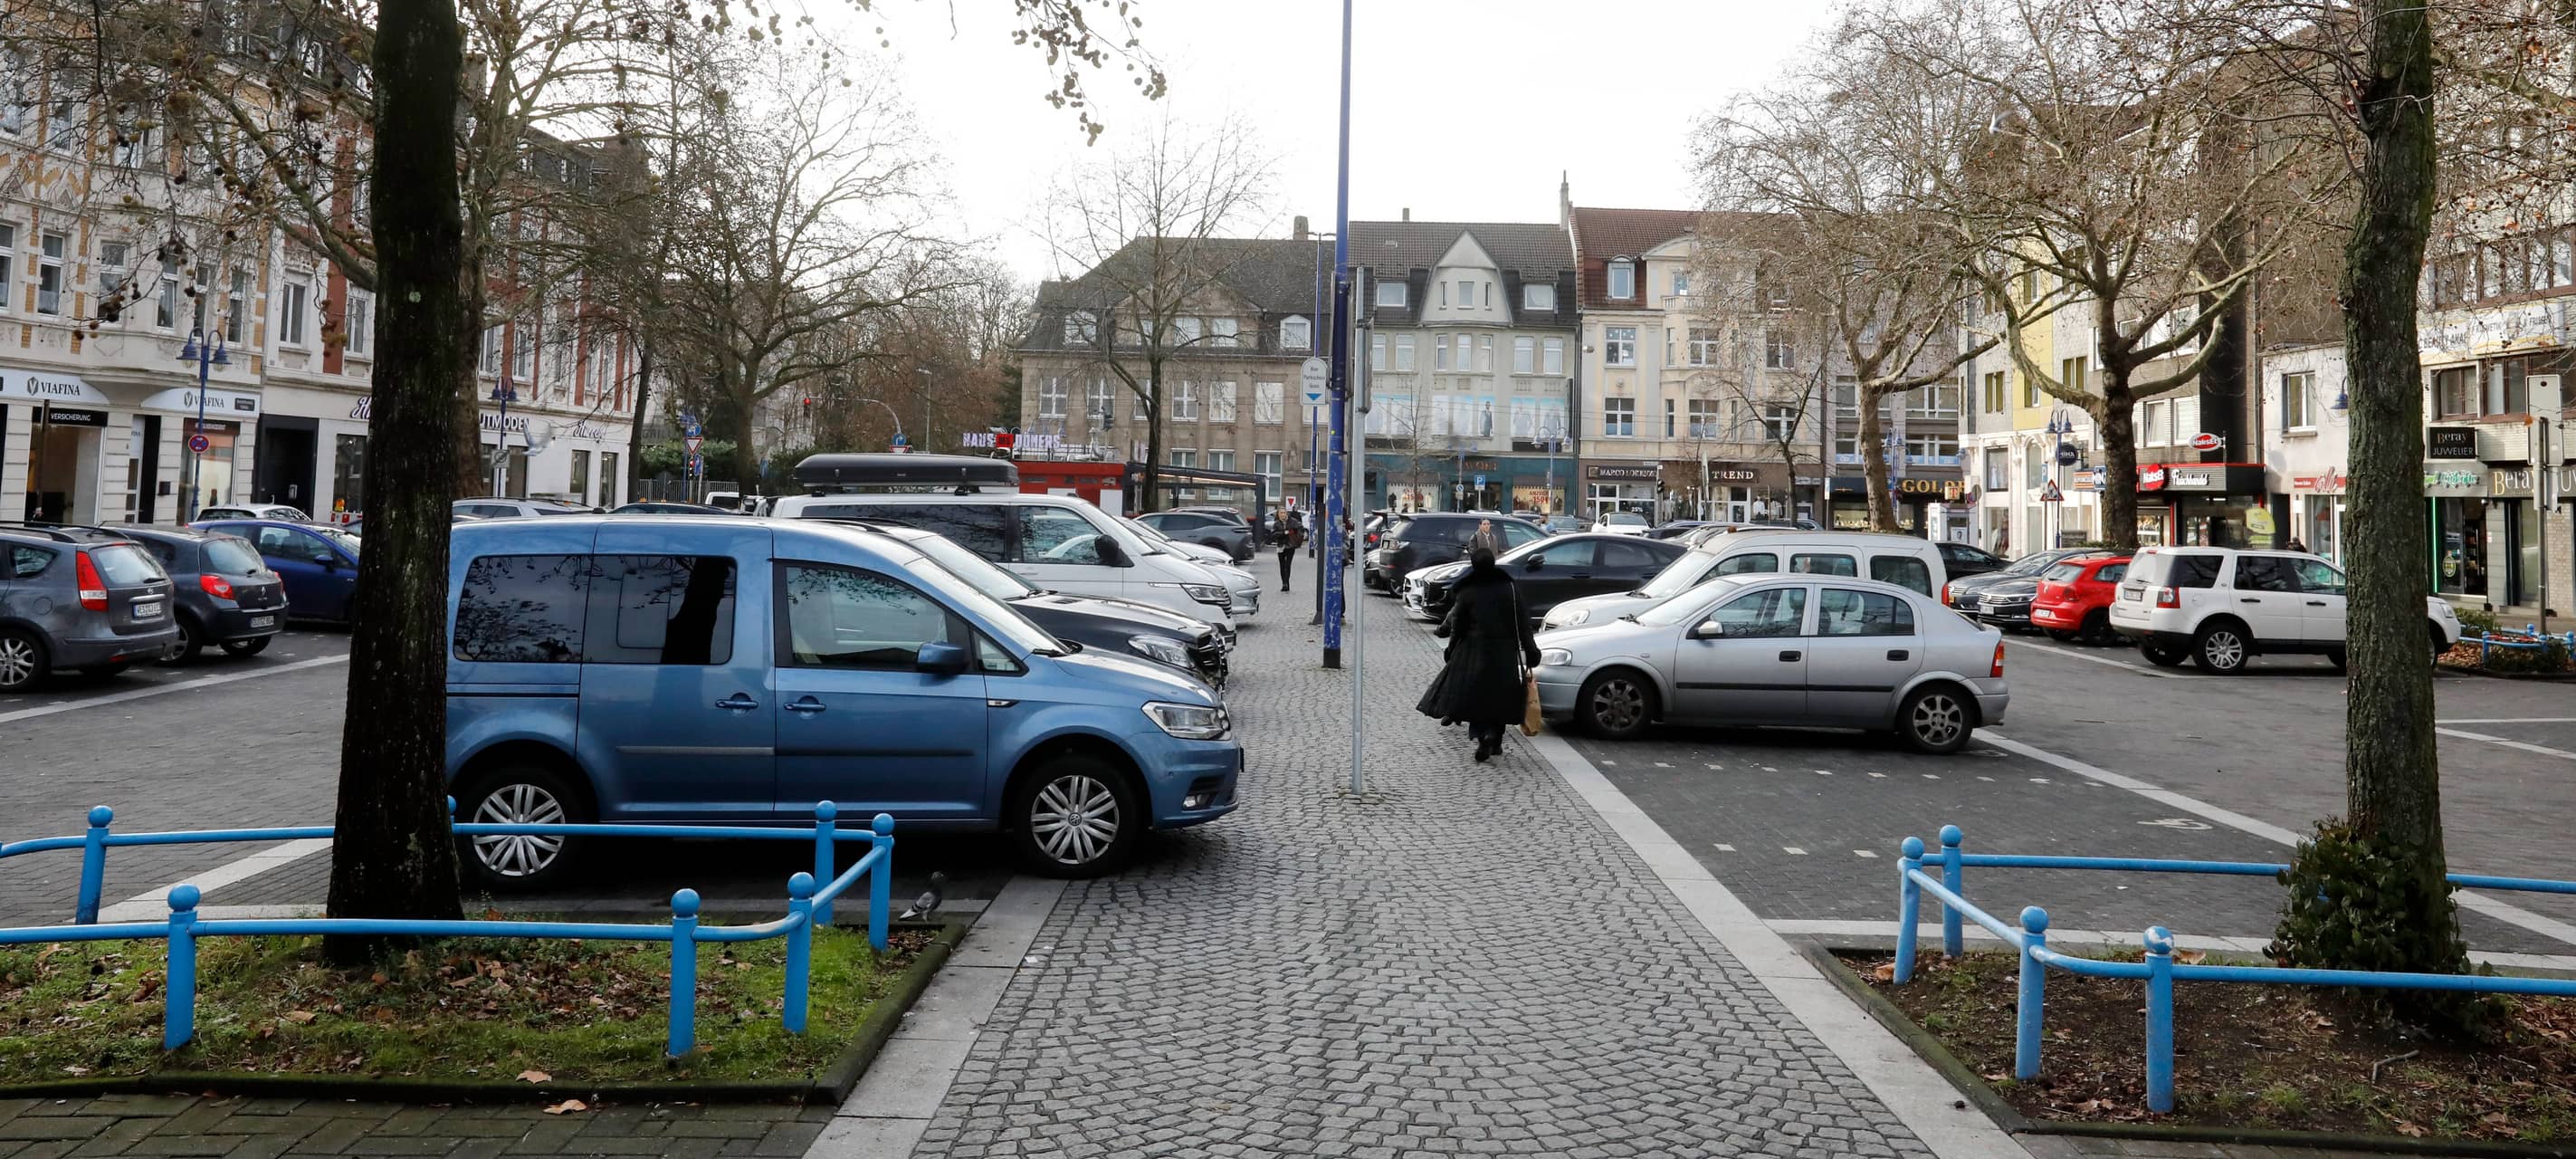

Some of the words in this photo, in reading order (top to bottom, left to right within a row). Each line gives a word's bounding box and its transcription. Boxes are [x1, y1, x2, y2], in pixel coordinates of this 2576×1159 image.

[41, 381, 81, 396] VIAFINA
[195, 395, 224, 407] VAFINA
[51, 413, 91, 422] VERSICHERUNG
[962, 432, 995, 447] HAUS
[2437, 432, 2468, 444] Beray
[2433, 447, 2474, 455] JUWELIER
[1711, 469, 1754, 480] TREND
